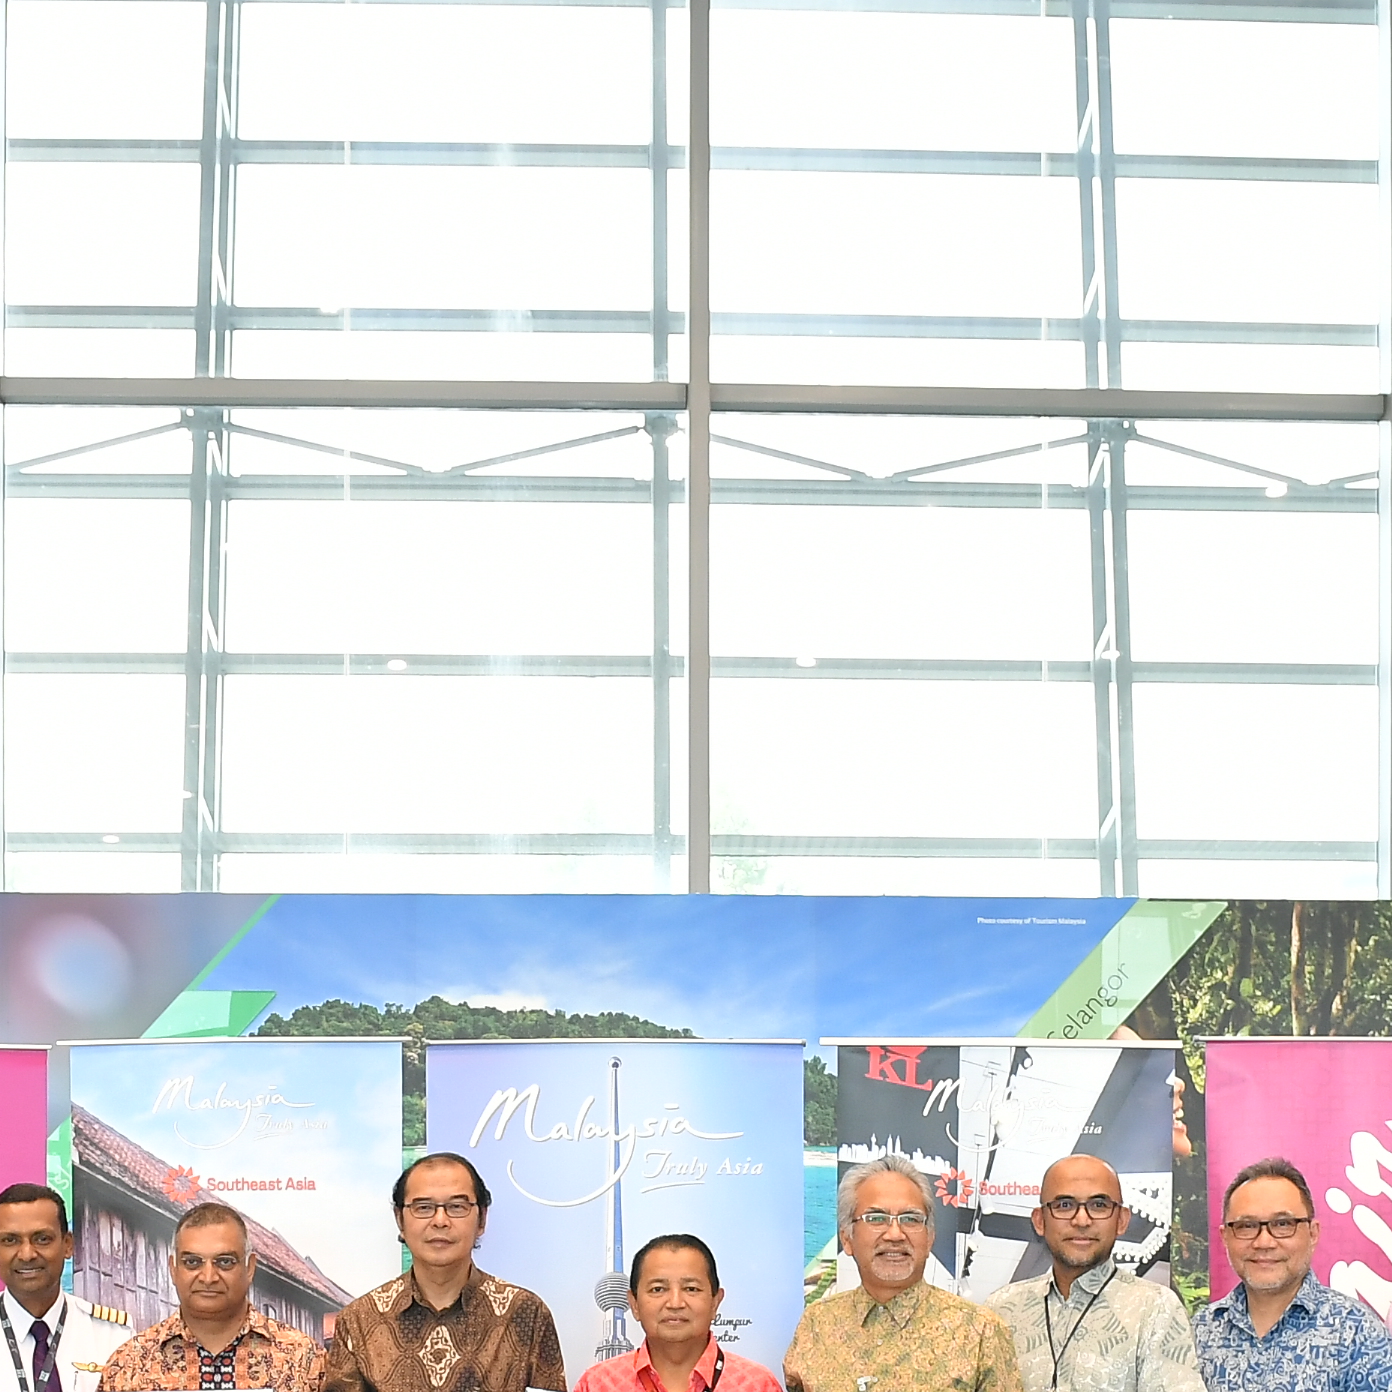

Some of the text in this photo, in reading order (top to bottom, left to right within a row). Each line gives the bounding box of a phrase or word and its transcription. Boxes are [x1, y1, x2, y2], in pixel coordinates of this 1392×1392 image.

[152, 1075, 316, 1150] Malaysia
[922, 1076, 1093, 1152] Malaysia
[469, 1083, 744, 1207] Malaysia
[641, 1152, 764, 1180] Truly Asia
[207, 1177, 317, 1191] Southeast Asia
[978, 1181, 1042, 1197] Southea
